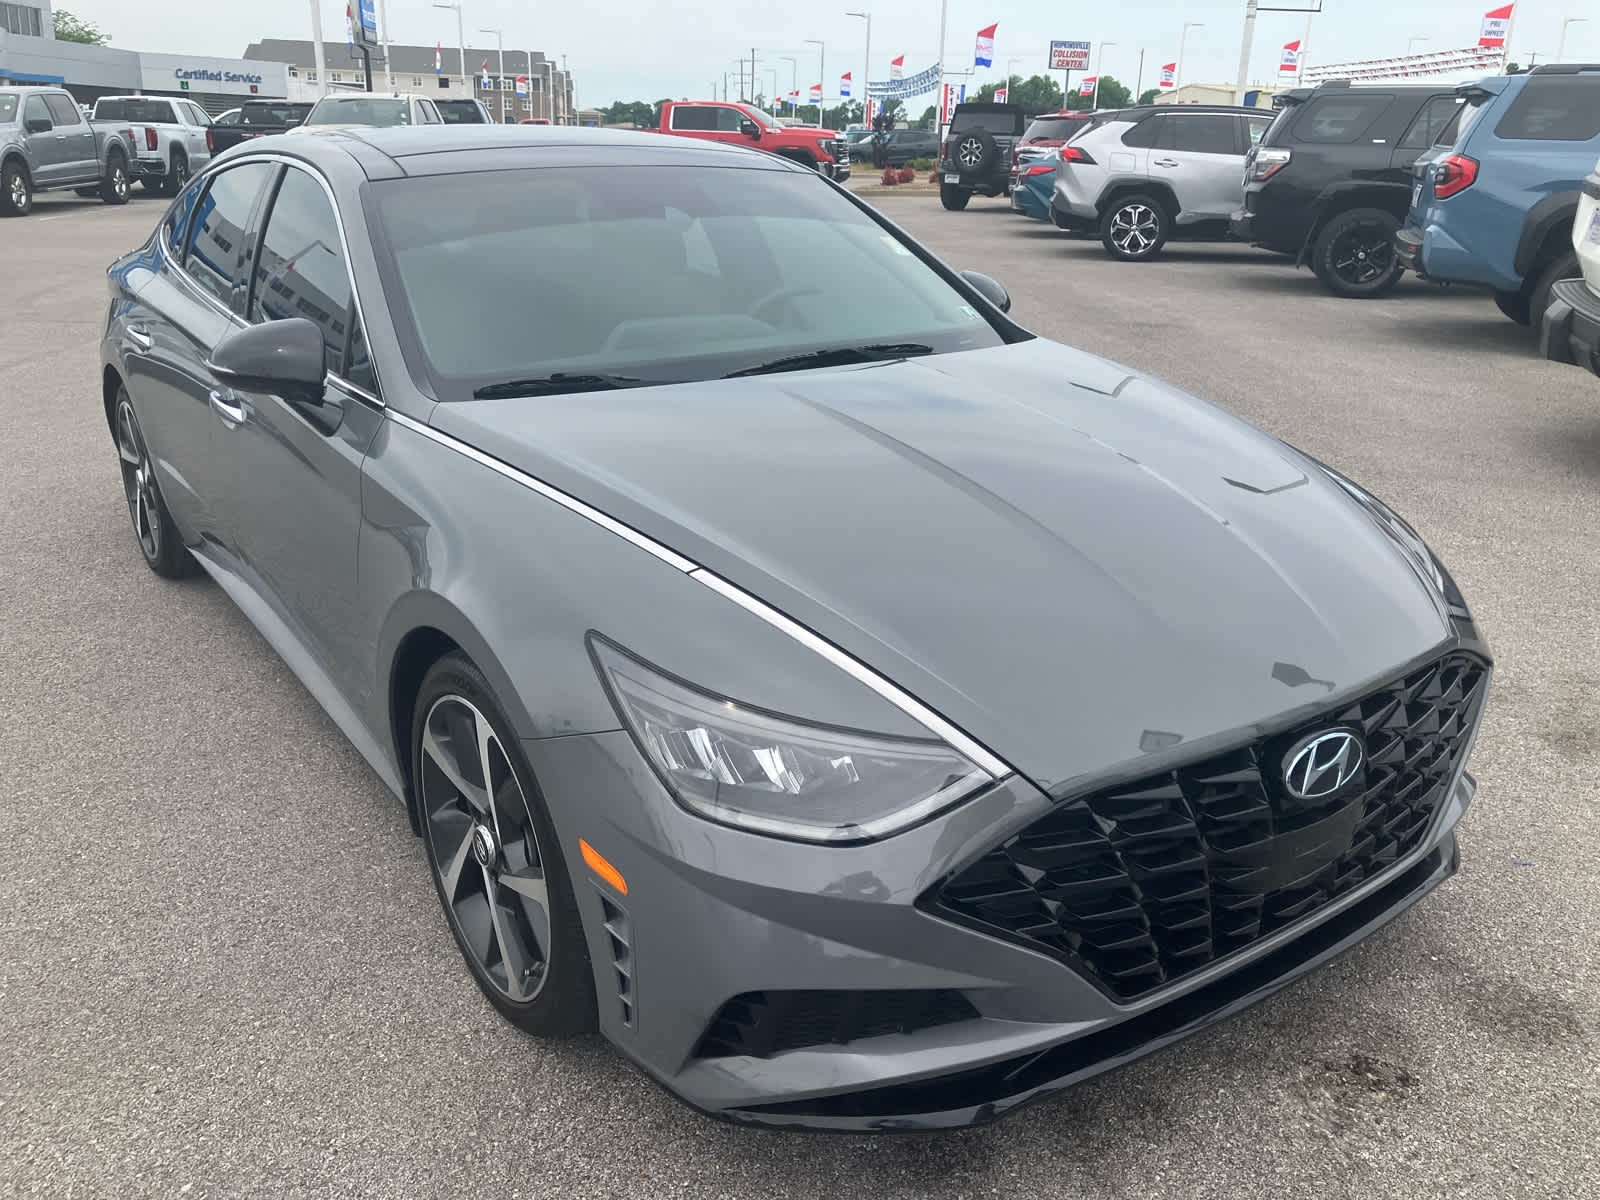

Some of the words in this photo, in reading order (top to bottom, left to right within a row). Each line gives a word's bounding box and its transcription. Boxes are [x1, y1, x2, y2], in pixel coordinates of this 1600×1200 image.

[1053, 49, 1088, 59] COLLISION
[1056, 59, 1083, 68] CENTER
[175, 68, 222, 81] Certified
[223, 71, 262, 84] Service
